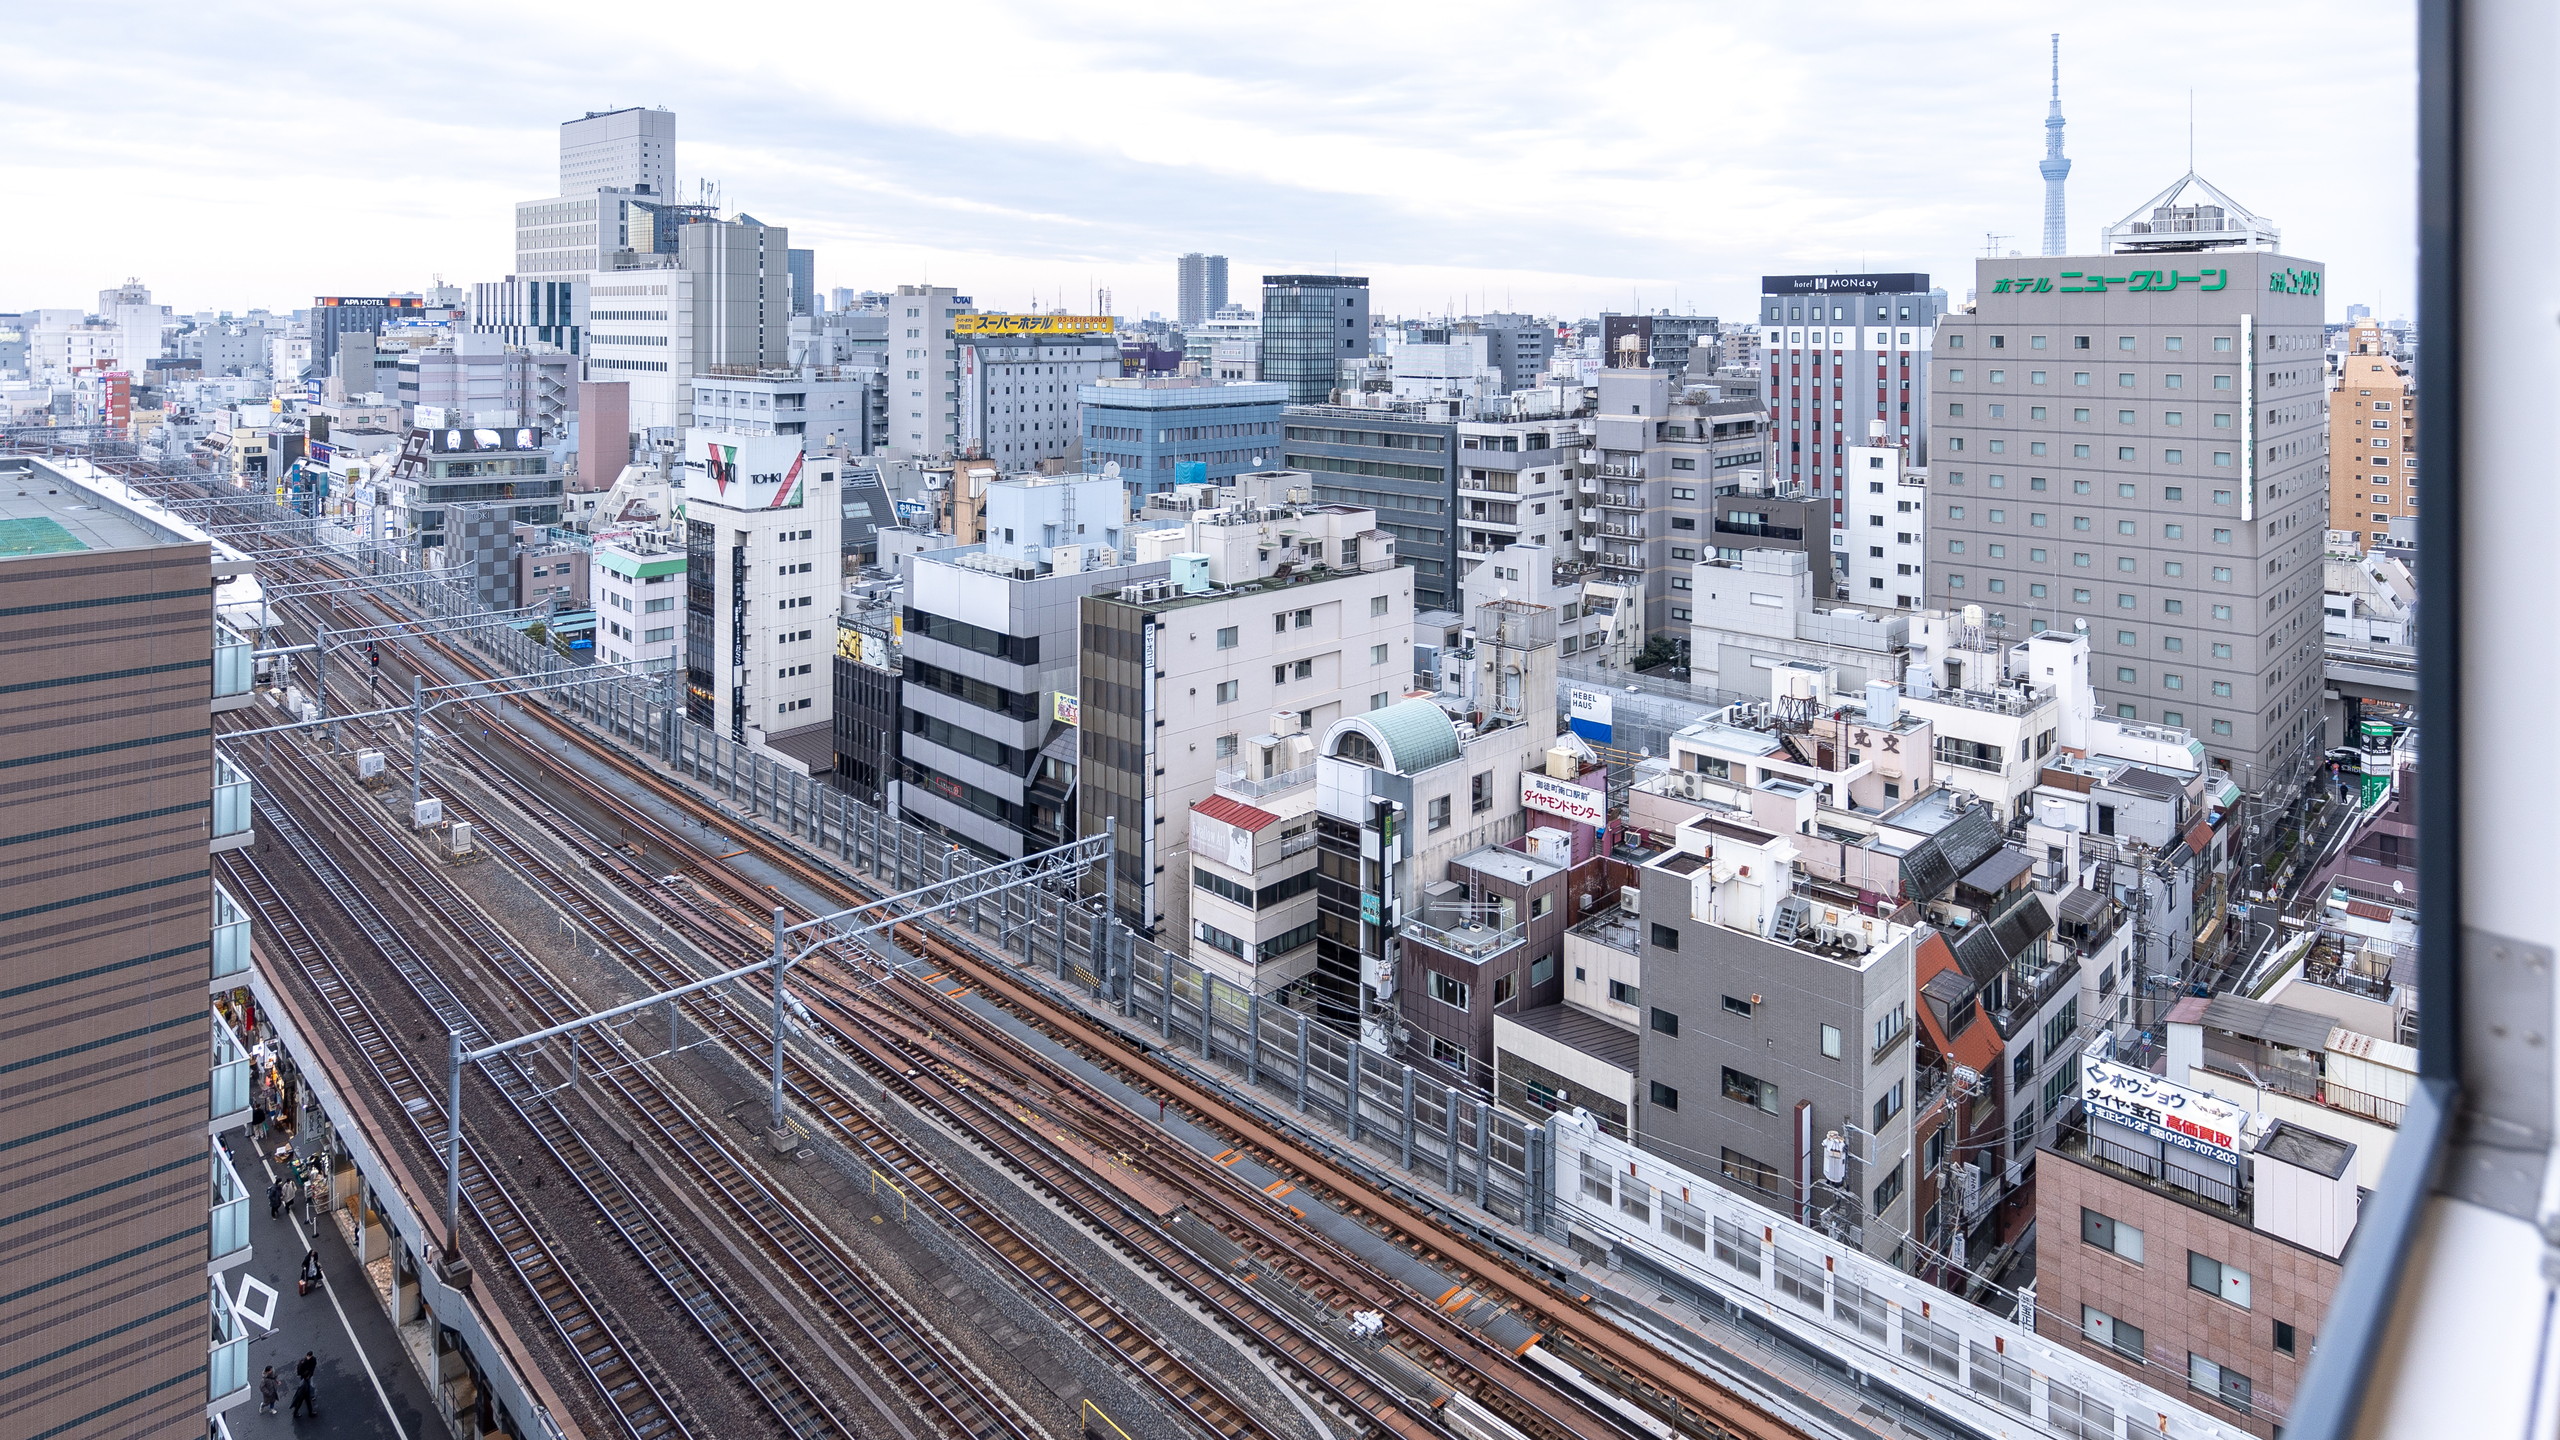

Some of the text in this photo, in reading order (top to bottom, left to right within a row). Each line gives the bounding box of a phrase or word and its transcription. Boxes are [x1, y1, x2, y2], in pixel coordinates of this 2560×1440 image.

[1794, 278, 1879, 289] hotel MONday
[1992, 269, 2227, 293] ホテル ニューグリーン
[2269, 267, 2321, 295] ホテル ニューグリーン
[976, 316, 1055, 330] スーパーホテル
[705, 458, 736, 483] TOHKI
[751, 472, 781, 485] TOHKI
[471, 512, 490, 520] TOKI
[1572, 691, 1597, 703] HEBEL
[1572, 700, 1592, 711] HAUS
[1854, 728, 1900, 755] 丸文
[1535, 780, 1591, 802] 御徒町南口駅前
[1524, 790, 1601, 819] ダイヤモンドセンター
[2109, 1073, 2187, 1109] ホウショウ
[2086, 1087, 2162, 1125] ダイヤ・宝石
[2095, 1106, 2238, 1165] 宝正ビル2F 0120-707-203
[2166, 1113, 2233, 1150] 高価買取
